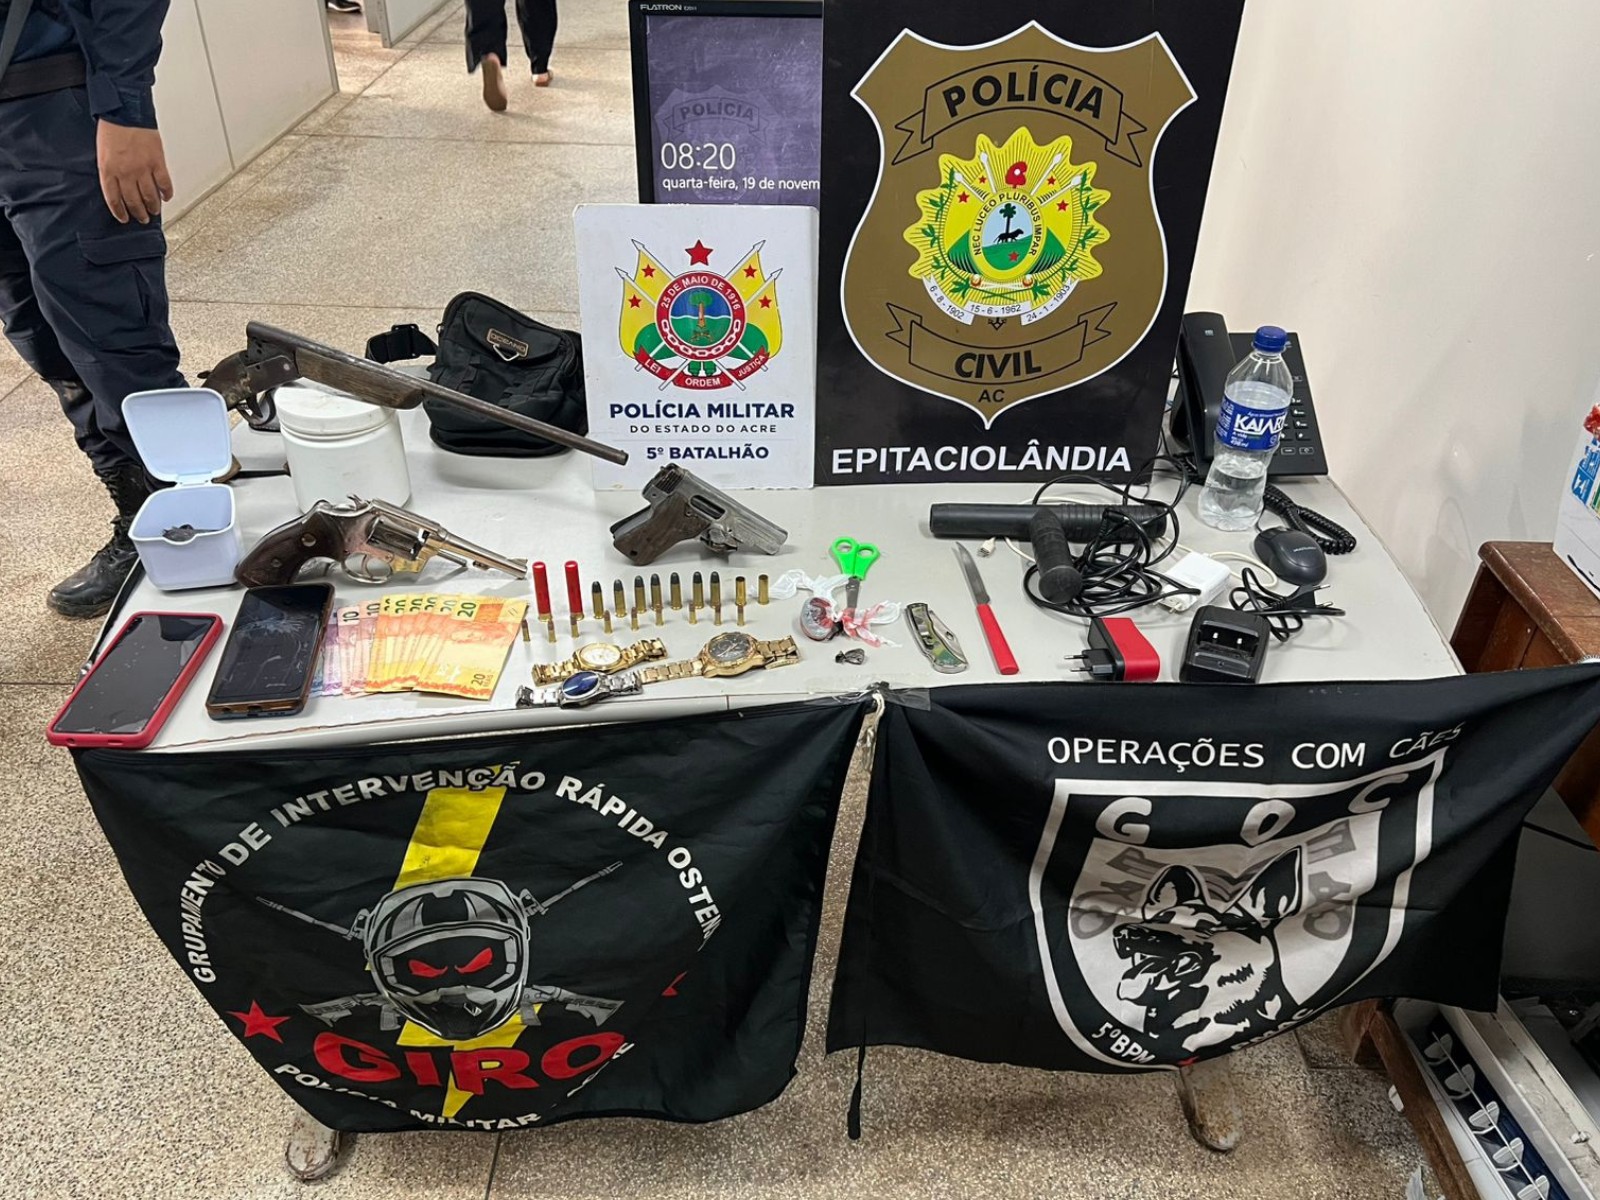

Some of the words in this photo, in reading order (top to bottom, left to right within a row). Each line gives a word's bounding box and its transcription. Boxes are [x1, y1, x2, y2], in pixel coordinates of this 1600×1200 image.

[942, 66, 1103, 119] POLÍCIA
[679, 101, 755, 120] POLÍCIA
[660, 142, 736, 170] 08:20
[662, 177, 739, 191] quarta-feira,
[742, 178, 755, 189] 19
[759, 178, 775, 189] de
[976, 199, 997, 231] LUCEO
[999, 193, 1042, 222] PLURIBUS
[972, 234, 981, 256] NEC
[1029, 223, 1043, 256] IMPAR
[661, 296, 671, 309] 25
[668, 283, 682, 297] DE
[682, 275, 708, 288] MAIO
[711, 278, 726, 291] DE
[644, 358, 661, 374] LEI
[737, 354, 766, 378] JUSTIÇA
[954, 349, 1042, 379] CIVIL
[685, 377, 721, 387] ORDEM
[978, 389, 1005, 403] AC
[609, 400, 701, 419] POLÍCIA
[707, 402, 795, 419] MILITAR
[630, 424, 649, 433] DO
[655, 424, 710, 433] ESTADO
[716, 424, 735, 433] DO
[740, 424, 777, 433] ACRE
[669, 443, 769, 460] BATALHÃO
[831, 439, 1132, 474] EPITACIOLÂNDIA
[342, 611, 359, 622] 10
[457, 602, 476, 617] 20
[471, 673, 486, 686] 20
[1047, 737, 1264, 773] OPERAÇÕES
[1291, 742, 1366, 768] COM
[1389, 721, 1466, 758] CÃES
[180, 859, 227, 984] GRUPAMENTO
[218, 822, 272, 867] DE
[270, 760, 546, 828] INTERVENÇÃO
[555, 775, 669, 850] RÁPIDA
[313, 1031, 628, 1096] GIRO
